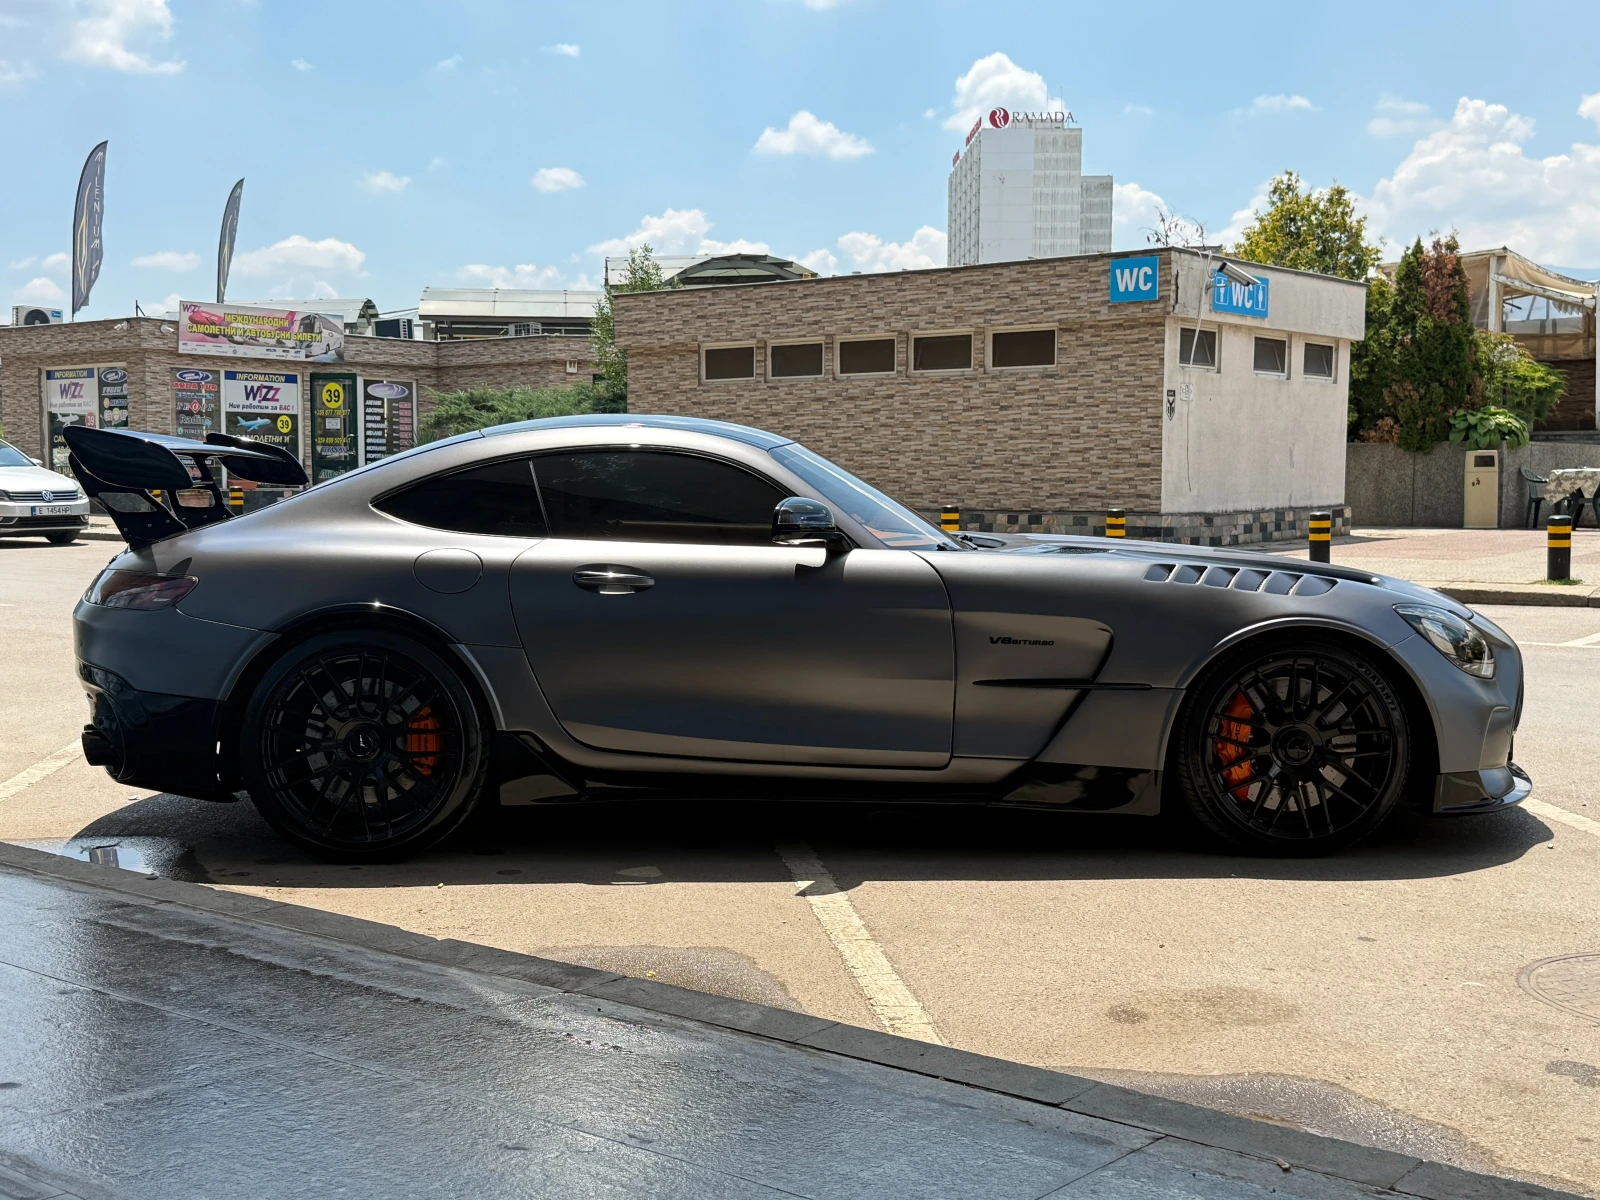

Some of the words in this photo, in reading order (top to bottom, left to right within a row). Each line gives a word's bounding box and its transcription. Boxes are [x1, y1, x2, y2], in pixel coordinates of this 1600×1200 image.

[1012, 111, 1075, 123] RAMADA
[90, 151, 103, 250] MILENIUM
[1116, 266, 1152, 292] WC
[1231, 281, 1253, 308] WC
[224, 313, 289, 327] МЕЖДУНАРОДНИ
[186, 323, 237, 336] САМОЛЕТНИ
[237, 328, 245, 336] И
[245, 328, 291, 340] АВТОБУСНИ
[292, 333, 322, 343] БИЛЕТИ
[55, 370, 88, 378] INFORMATION
[236, 373, 286, 382] INFORMATION
[325, 389, 341, 403] 39
[87, 416, 95, 426] 39
[279, 420, 289, 430] 39
